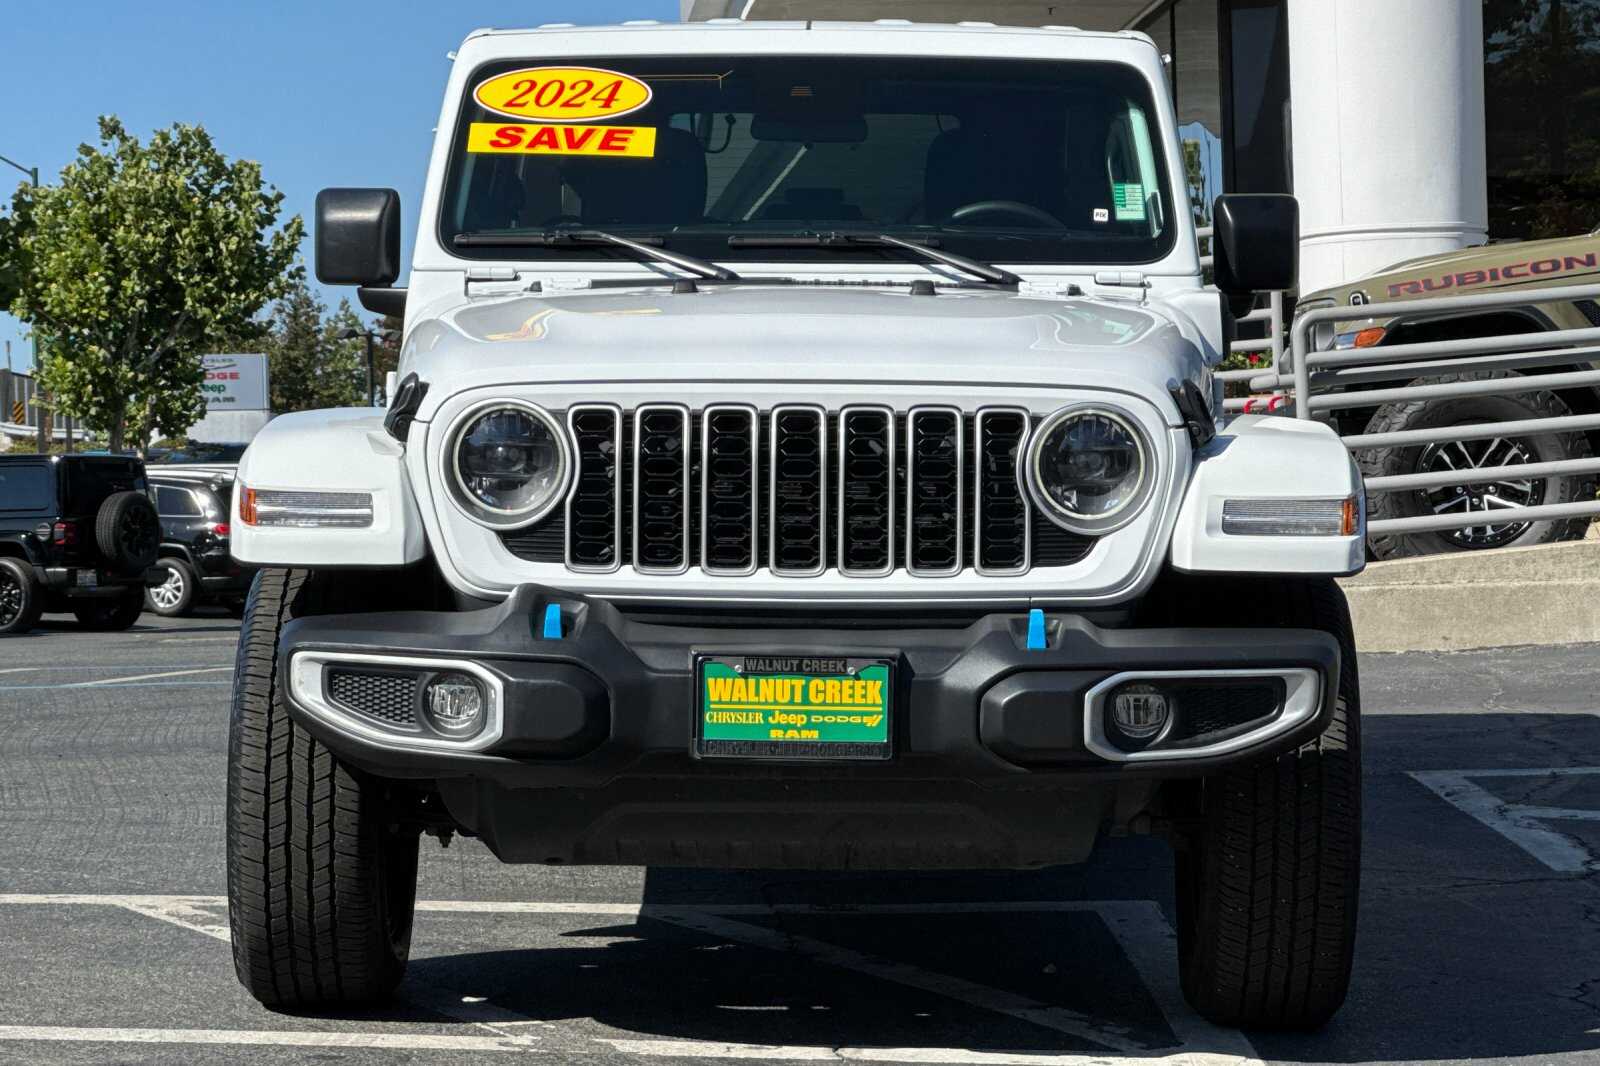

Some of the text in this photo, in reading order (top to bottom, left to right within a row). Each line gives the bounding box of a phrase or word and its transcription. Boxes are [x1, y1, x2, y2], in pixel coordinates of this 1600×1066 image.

[503, 79, 623, 109] 2024
[489, 126, 634, 152] SAVE
[1387, 252, 1597, 298] RUBICON
[205, 372, 240, 380] DGE
[201, 384, 226, 394] eep
[745, 659, 845, 673] WALNUT CREEK
[707, 678, 882, 704] WALNUT CREEK
[705, 711, 764, 725] CHRYSLER
[767, 710, 807, 727] Jeep
[769, 729, 819, 739] RAM
